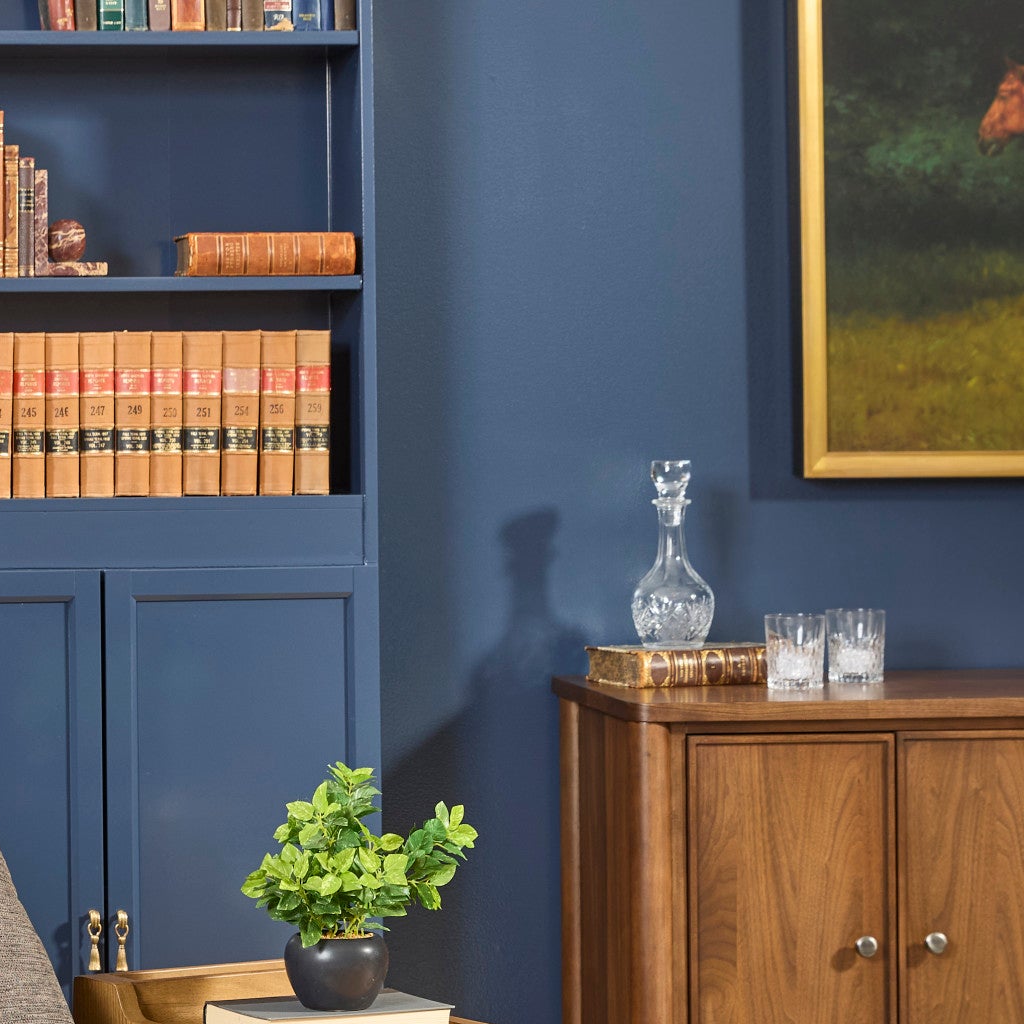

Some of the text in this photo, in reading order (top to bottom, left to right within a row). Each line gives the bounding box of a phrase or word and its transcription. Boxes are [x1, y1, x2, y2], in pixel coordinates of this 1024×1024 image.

[21, 407, 37, 418] 245
[90, 405, 105, 416] 247
[127, 405, 143, 415] 249
[196, 407, 211, 418] 251
[269, 403, 284, 414] 256
